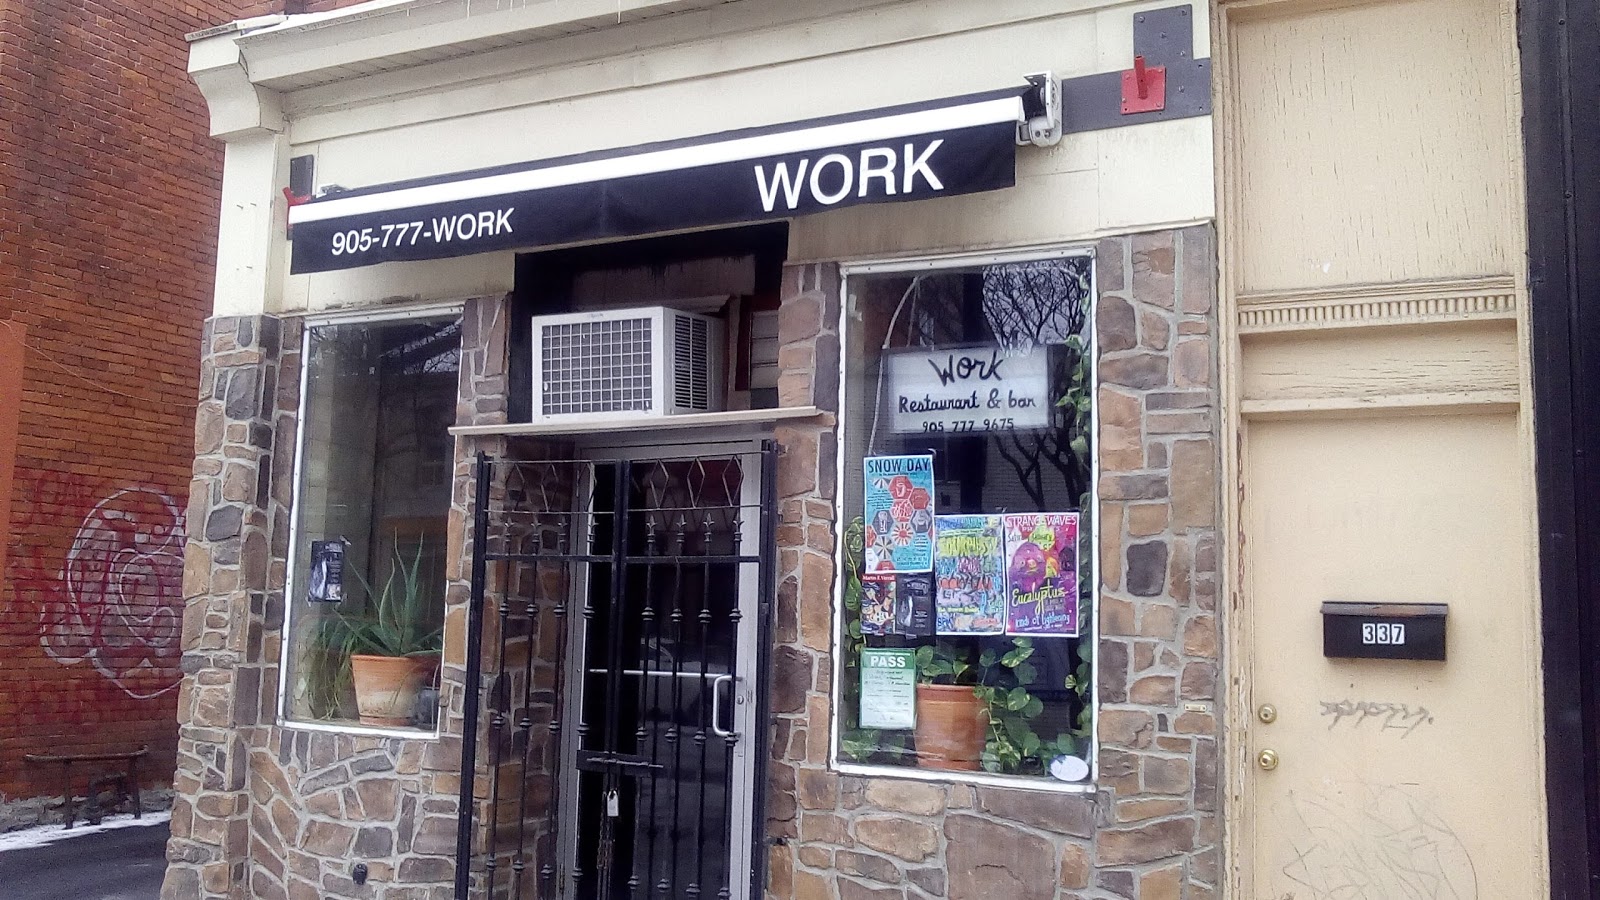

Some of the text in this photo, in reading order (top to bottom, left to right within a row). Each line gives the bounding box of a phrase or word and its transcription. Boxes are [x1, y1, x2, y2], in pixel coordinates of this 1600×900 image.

[754, 139, 945, 212] WORK
[331, 207, 515, 256] 905-777-WORK
[928, 349, 1004, 387] Work
[898, 388, 1036, 413] Restaurant & bar
[922, 418, 1014, 432] 905 777 9675
[868, 458, 929, 473] SNOW DAY
[1011, 578, 1069, 615] Eucalyptus
[1364, 625, 1403, 642] 337
[870, 655, 906, 668] PASS
